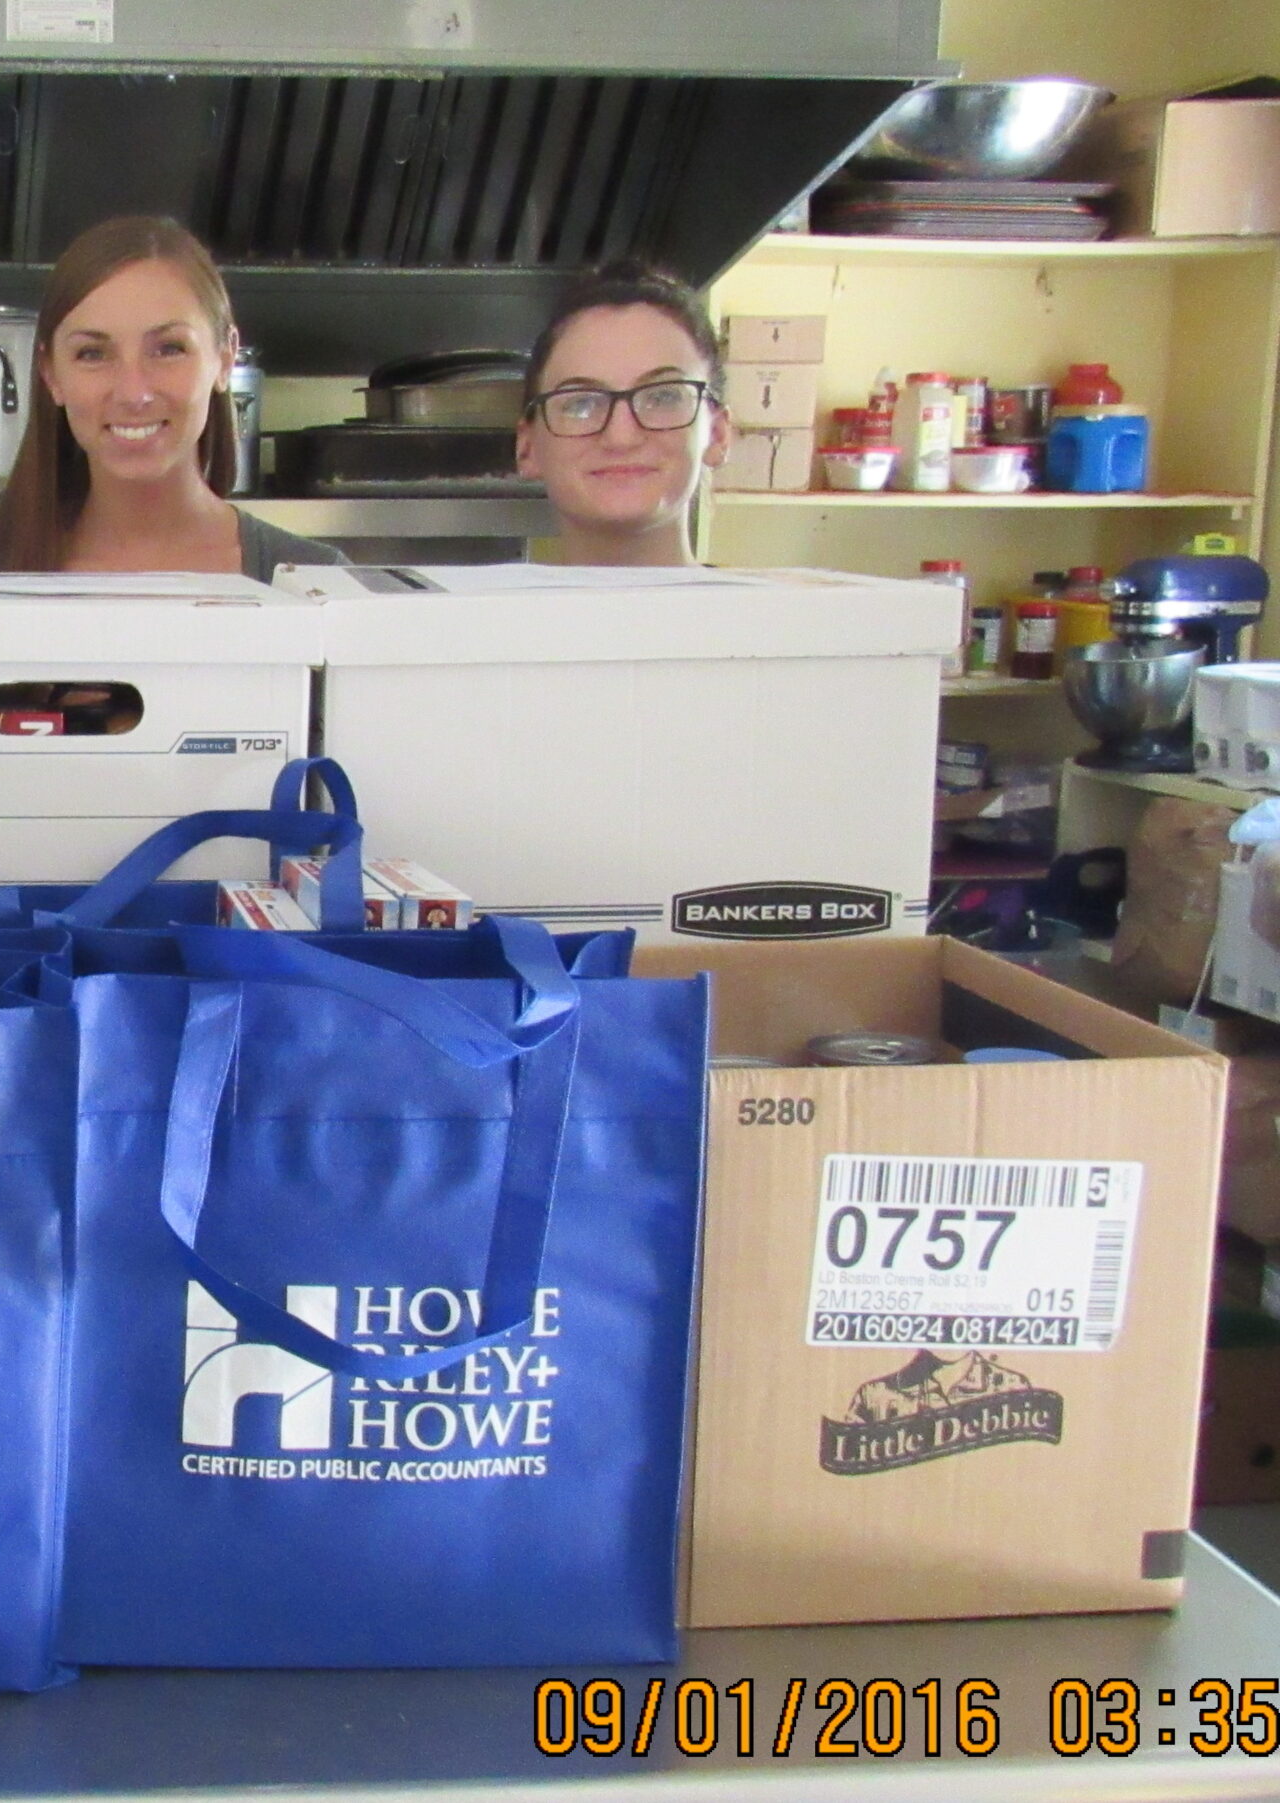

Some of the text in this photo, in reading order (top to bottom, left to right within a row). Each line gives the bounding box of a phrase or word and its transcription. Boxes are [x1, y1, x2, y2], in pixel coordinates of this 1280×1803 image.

[686, 902, 877, 922] BANKERS BOX
[738, 1097, 815, 1126] 5280
[1087, 1171, 1109, 1202] 5
[825, 1205, 1017, 1271] 0757
[839, 1271, 881, 1286] Boston
[884, 1273, 924, 1287] Creme
[928, 1274, 951, 1287] Roll
[816, 1289, 924, 1311] 2M123567
[1026, 1287, 1075, 1313] 015
[816, 1314, 1076, 1345] 20160924 08142041
[348, 1399, 553, 1452] HOWE
[833, 1402, 1050, 1462] Little Debbie
[182, 1453, 546, 1482] CERTIFIED PUBLIC ACCOUNTANTS
